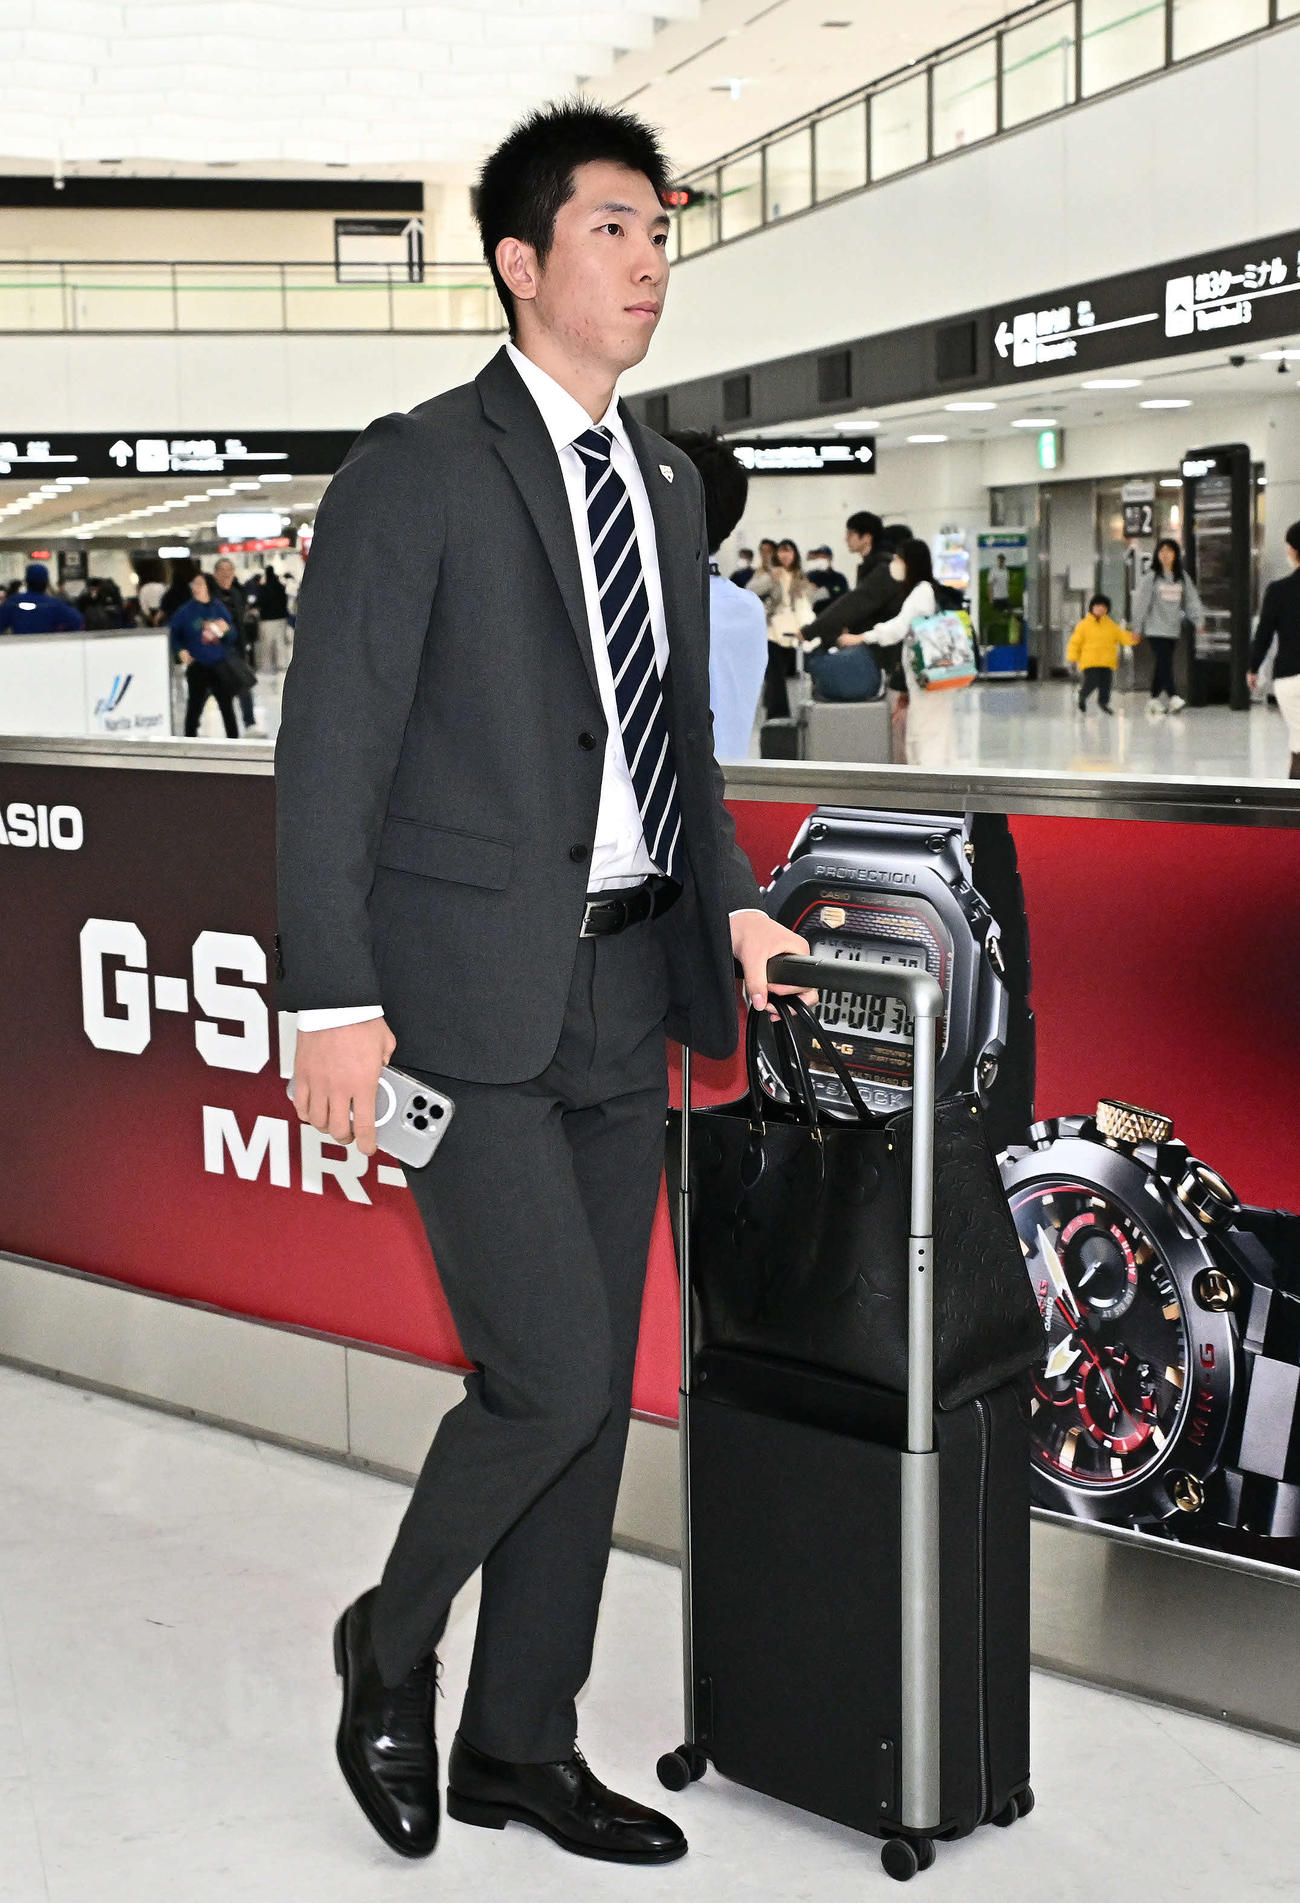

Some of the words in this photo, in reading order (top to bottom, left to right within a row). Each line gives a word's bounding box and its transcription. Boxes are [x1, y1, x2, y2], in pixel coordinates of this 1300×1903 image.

[1242, 300, 1252, 324] 3
[1142, 505, 1152, 533] 2
[815, 864, 917, 886] PROTECTION
[820, 889, 851, 901] CASIO
[79, 918, 297, 1080] G-S
[812, 1038, 854, 1056] M-G
[811, 1079, 904, 1107] -SOCK
[1128, 1261, 1137, 1276] AL
[1044, 1296, 1054, 1332] CASIO
[1187, 1343, 1216, 1447] MR-G
